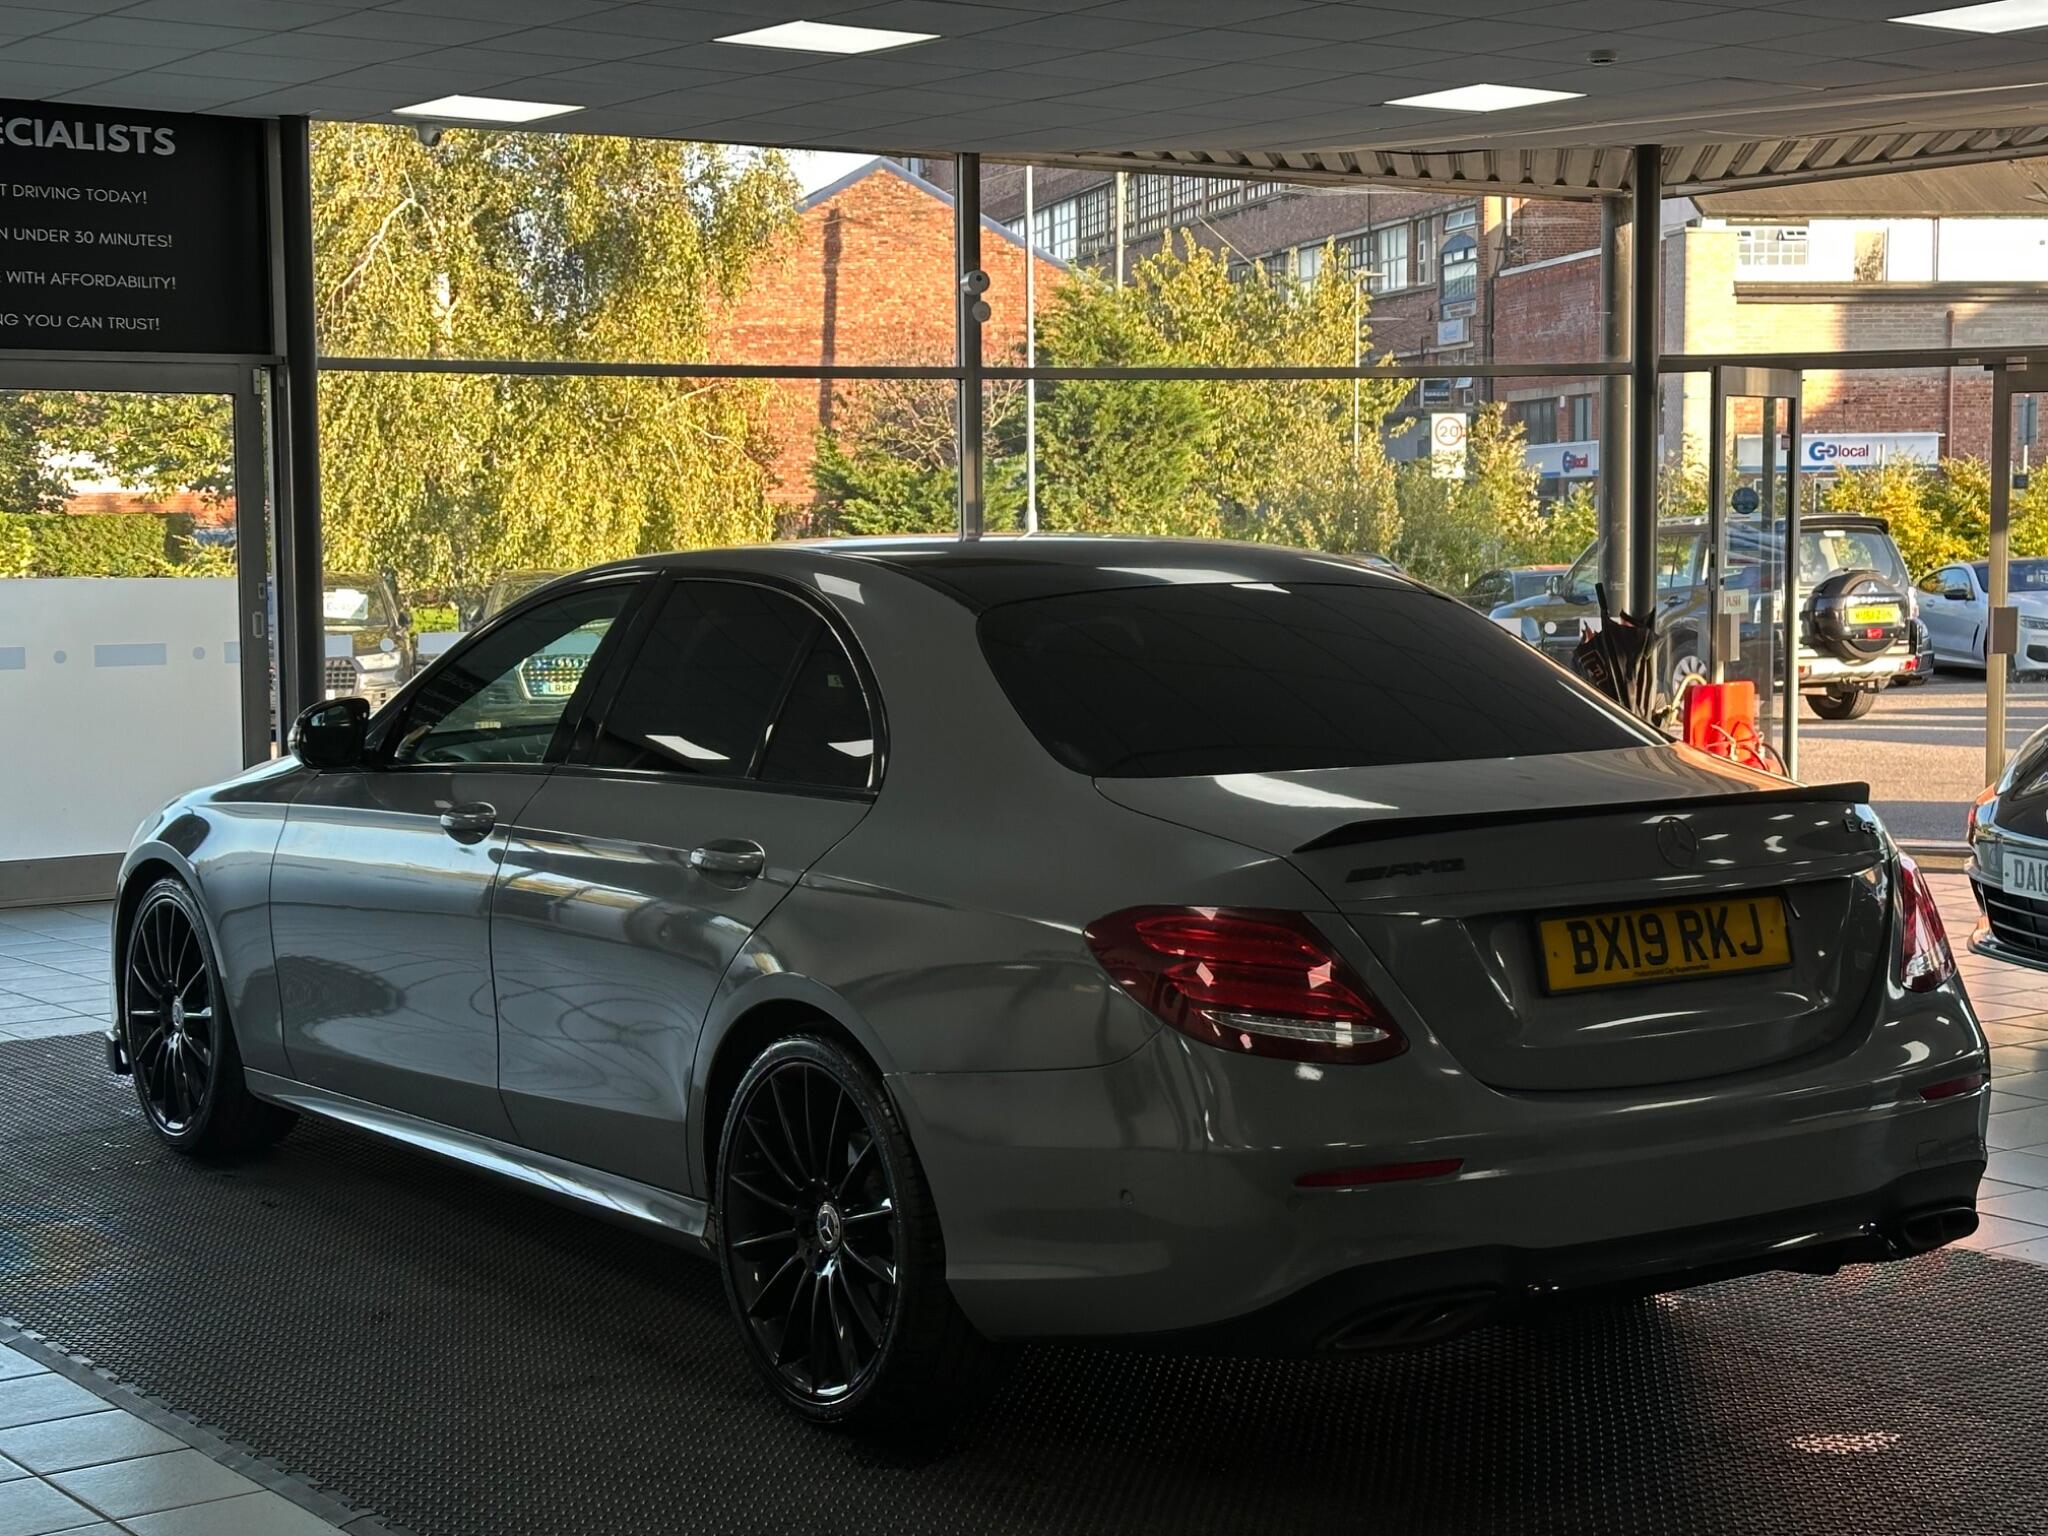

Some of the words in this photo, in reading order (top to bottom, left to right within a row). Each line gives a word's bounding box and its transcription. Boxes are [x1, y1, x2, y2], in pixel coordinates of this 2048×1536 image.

[0, 116, 176, 156] CIALISTS
[12, 184, 81, 200] DRIVING
[86, 187, 148, 204] TODAY!
[14, 227, 69, 243] UNDER
[74, 230, 94, 244] 30
[99, 232, 173, 248] MINUTES!
[6, 270, 45, 285] WITH
[50, 272, 176, 289] AFFORDABILITY!
[23, 313, 62, 328] YOU
[67, 315, 103, 329] CAN
[108, 316, 160, 331] TRUST!
[1440, 425, 1459, 438] 20
[1566, 912, 1670, 975] BX19
[1675, 903, 1765, 963] RKJ
